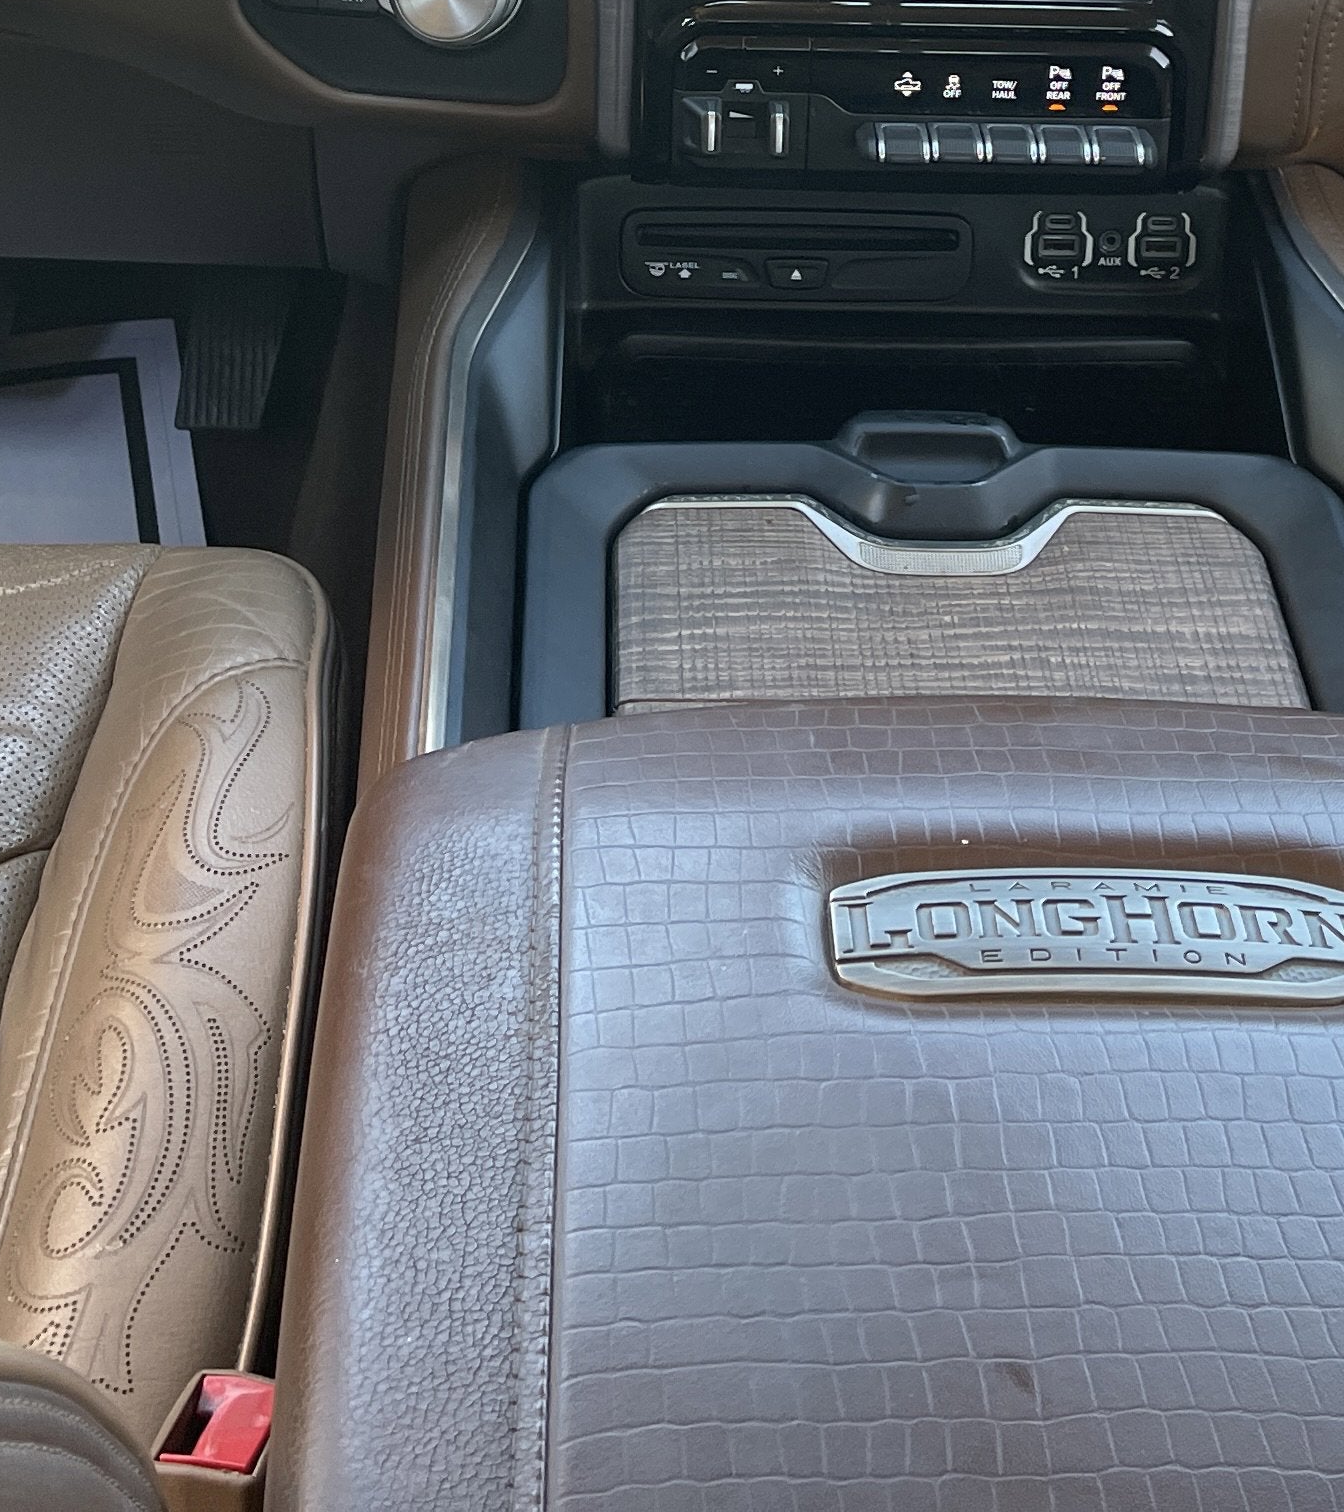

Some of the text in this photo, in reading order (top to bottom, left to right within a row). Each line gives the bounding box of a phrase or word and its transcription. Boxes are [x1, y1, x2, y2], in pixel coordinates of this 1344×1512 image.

[992, 80, 1017, 89] TOW/
[1050, 81, 1069, 90] OFF
[1102, 82, 1121, 91] OFF
[943, 90, 961, 98] OFF
[992, 91, 1017, 99] HAUL
[1046, 91, 1070, 100] REAR
[1096, 92, 1127, 101] FRONT
[1098, 257, 1122, 266] AUX
[1071, 266, 1079, 279] 1
[1169, 266, 1180, 280] 2
[968, 880, 1230, 896] LARAMIE
[979, 947, 1248, 967] EDITION
